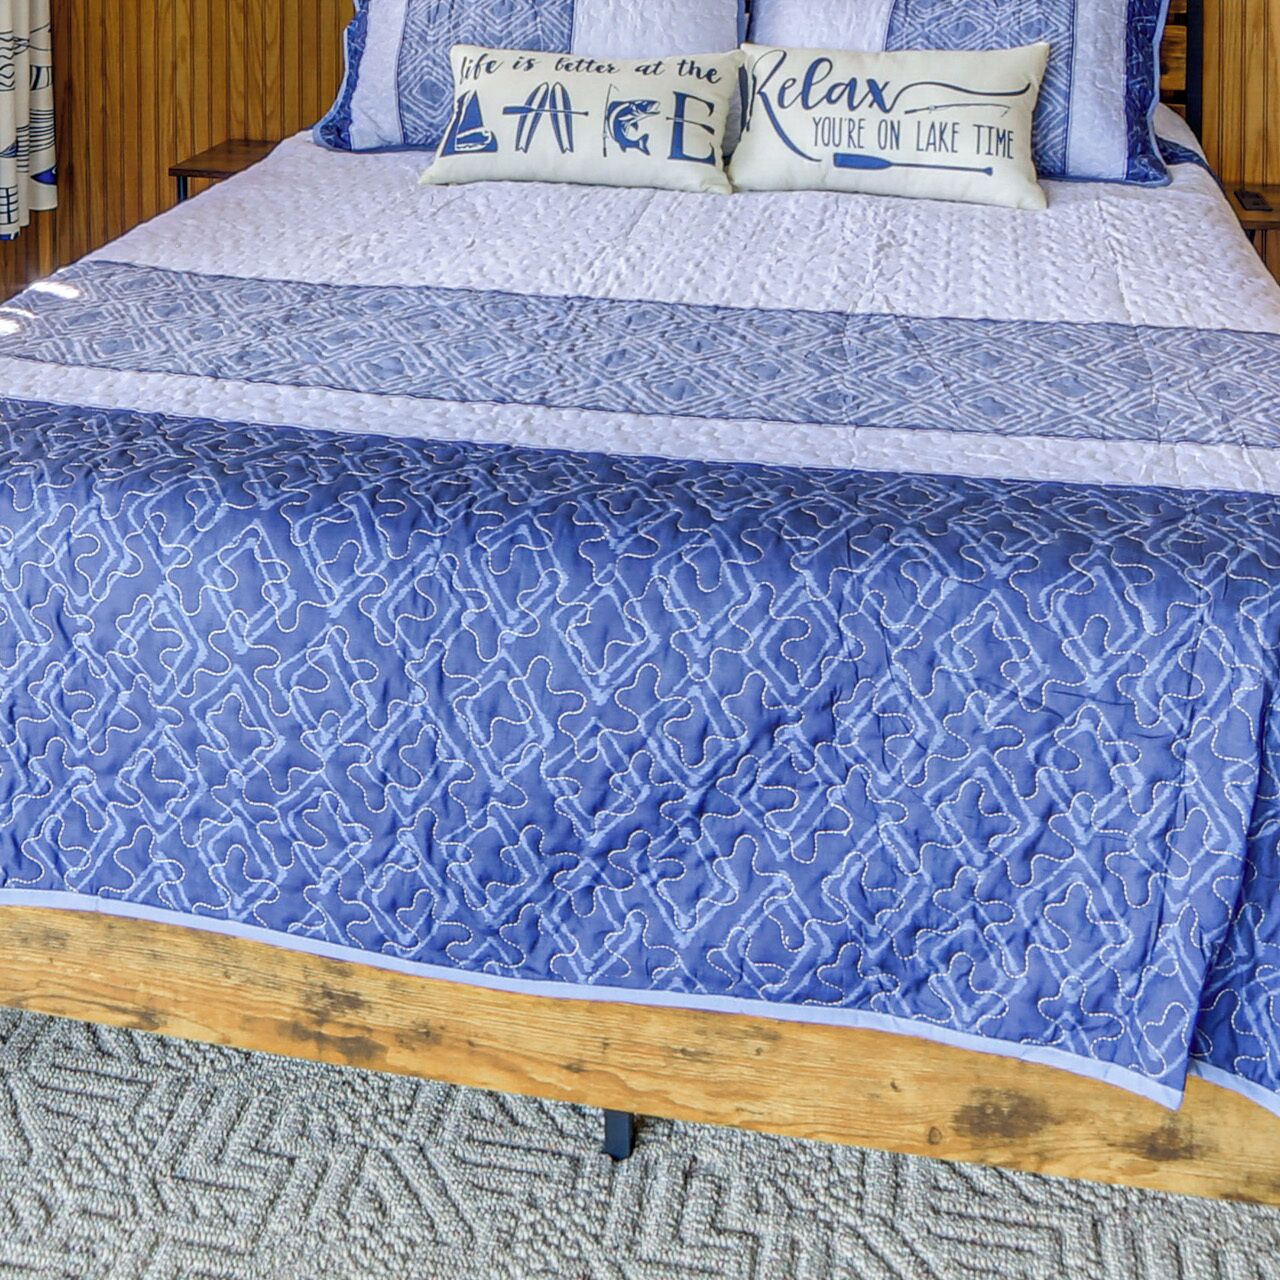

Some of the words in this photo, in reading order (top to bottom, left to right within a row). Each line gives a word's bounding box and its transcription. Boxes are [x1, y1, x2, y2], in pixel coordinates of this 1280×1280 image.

[512, 56, 542, 72] is
[555, 56, 620, 74] better
[634, 60, 665, 76] at
[676, 59, 722, 84] the
[739, 49, 910, 161] Relax
[811, 116, 866, 149] YOU'RE
[877, 119, 901, 151] ON
[915, 120, 961, 154] LAKE
[972, 123, 1014, 160] TIME
